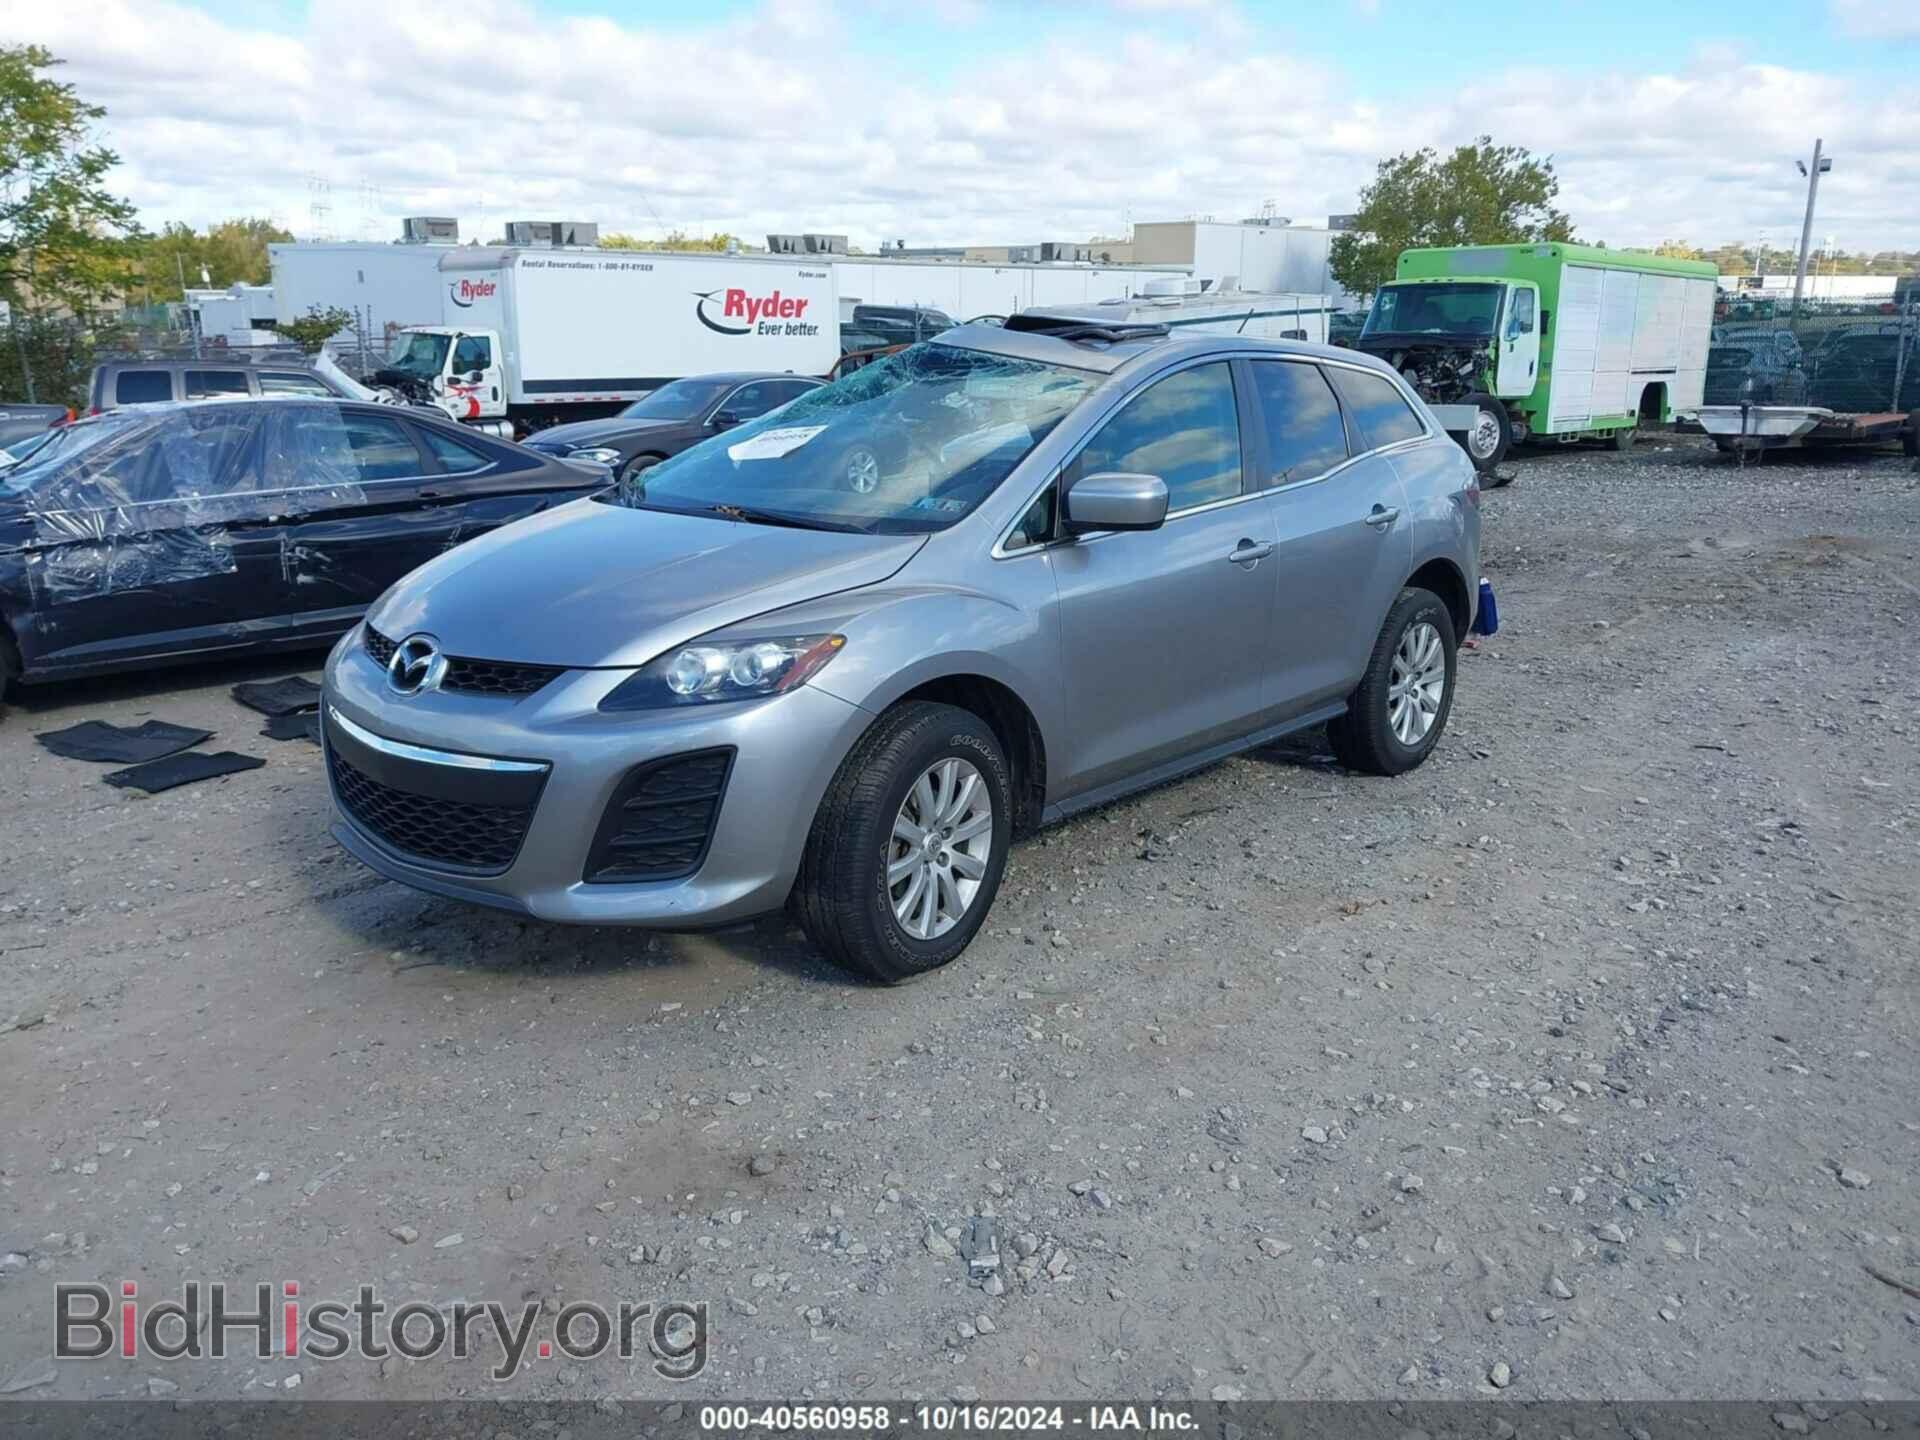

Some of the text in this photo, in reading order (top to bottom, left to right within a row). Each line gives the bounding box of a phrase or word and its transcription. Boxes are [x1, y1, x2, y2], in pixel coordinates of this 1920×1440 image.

[522, 259, 545, 268] Rental
[461, 278, 496, 301] Ryder
[724, 288, 808, 324] Ryder
[757, 321, 782, 336] Ever
